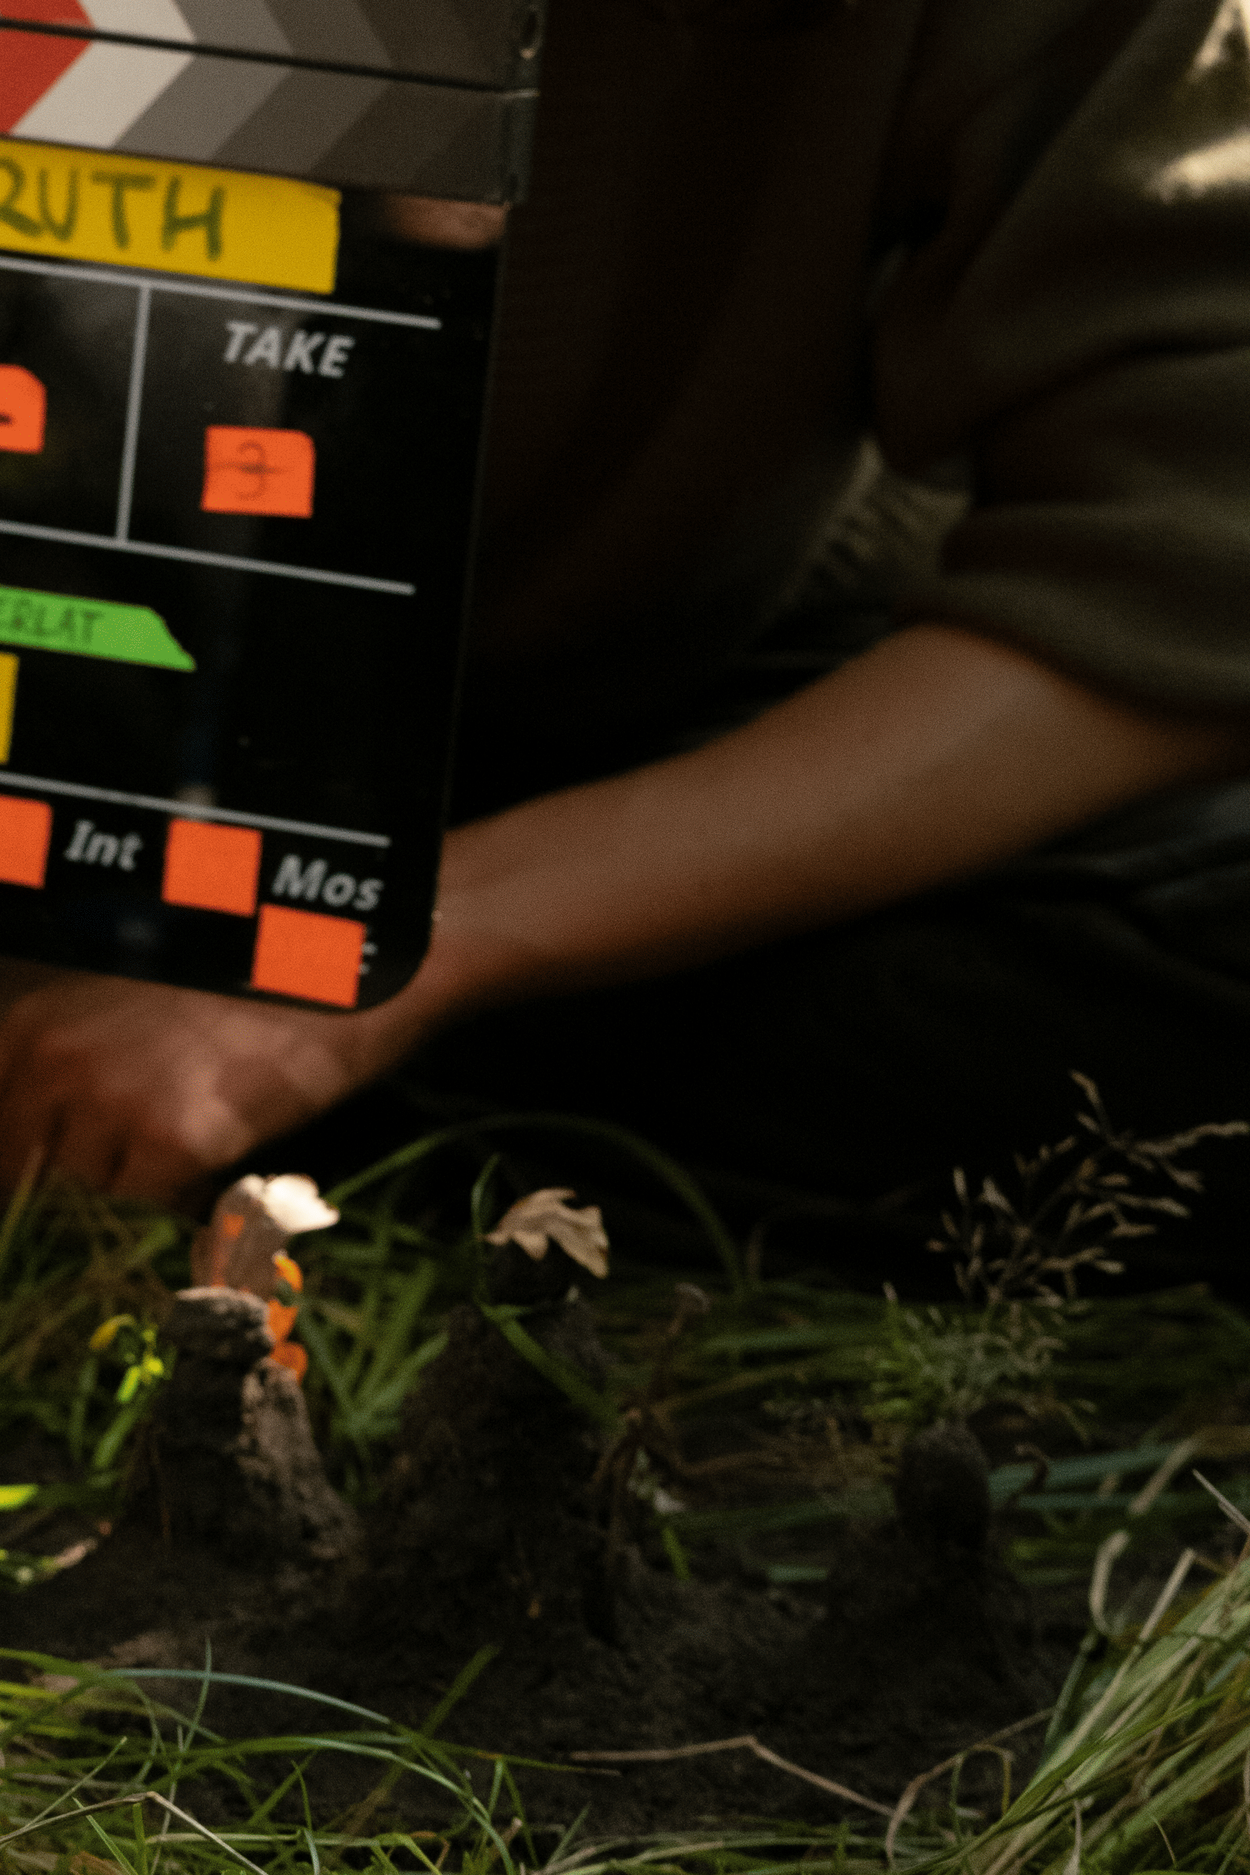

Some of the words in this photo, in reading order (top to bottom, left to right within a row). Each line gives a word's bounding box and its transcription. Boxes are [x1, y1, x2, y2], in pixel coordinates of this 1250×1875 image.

[222, 321, 354, 379] TAKE
[65, 820, 144, 872] Int
[272, 854, 384, 911] Mos
